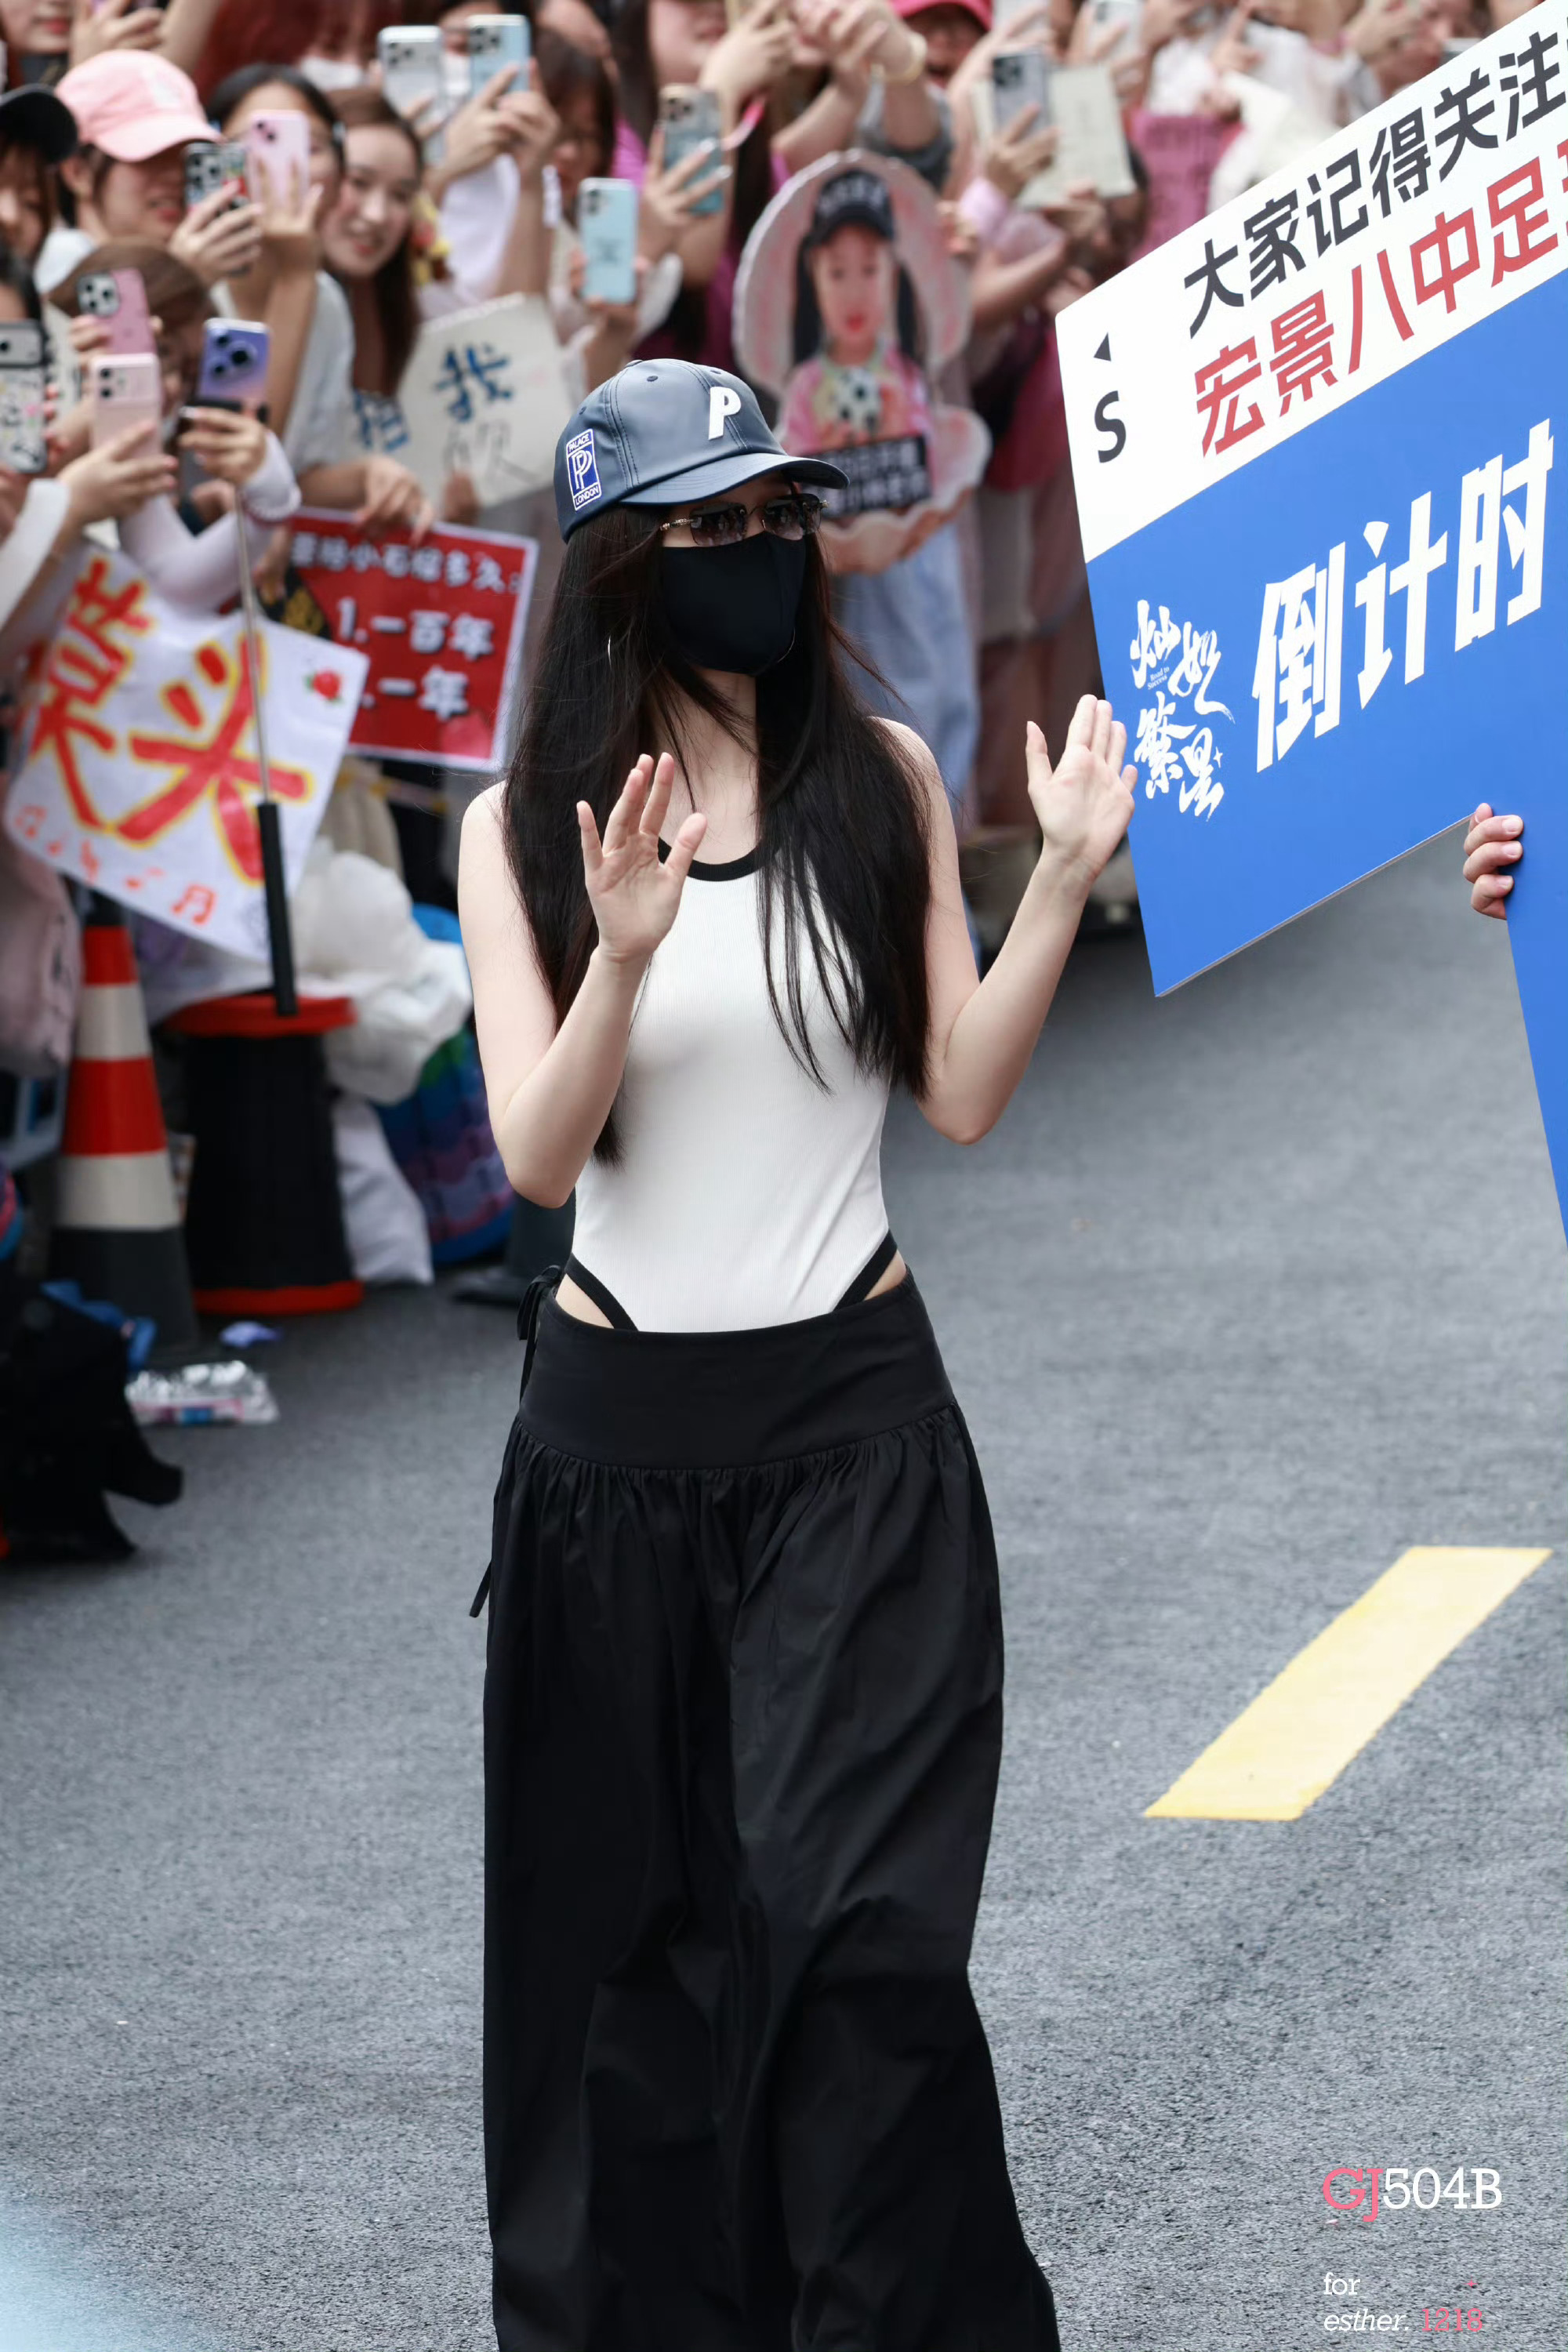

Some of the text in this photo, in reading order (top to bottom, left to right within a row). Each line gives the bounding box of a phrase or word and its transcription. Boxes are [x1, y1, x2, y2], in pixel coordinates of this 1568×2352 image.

[1184, 16, 1568, 339] 大家记得关注
[568, 434, 590, 452] PALACE
[709, 386, 742, 441] P
[1094, 390, 1127, 463] S
[575, 485, 599, 506] LONDON
[1252, 418, 1554, 773] 倒计时
